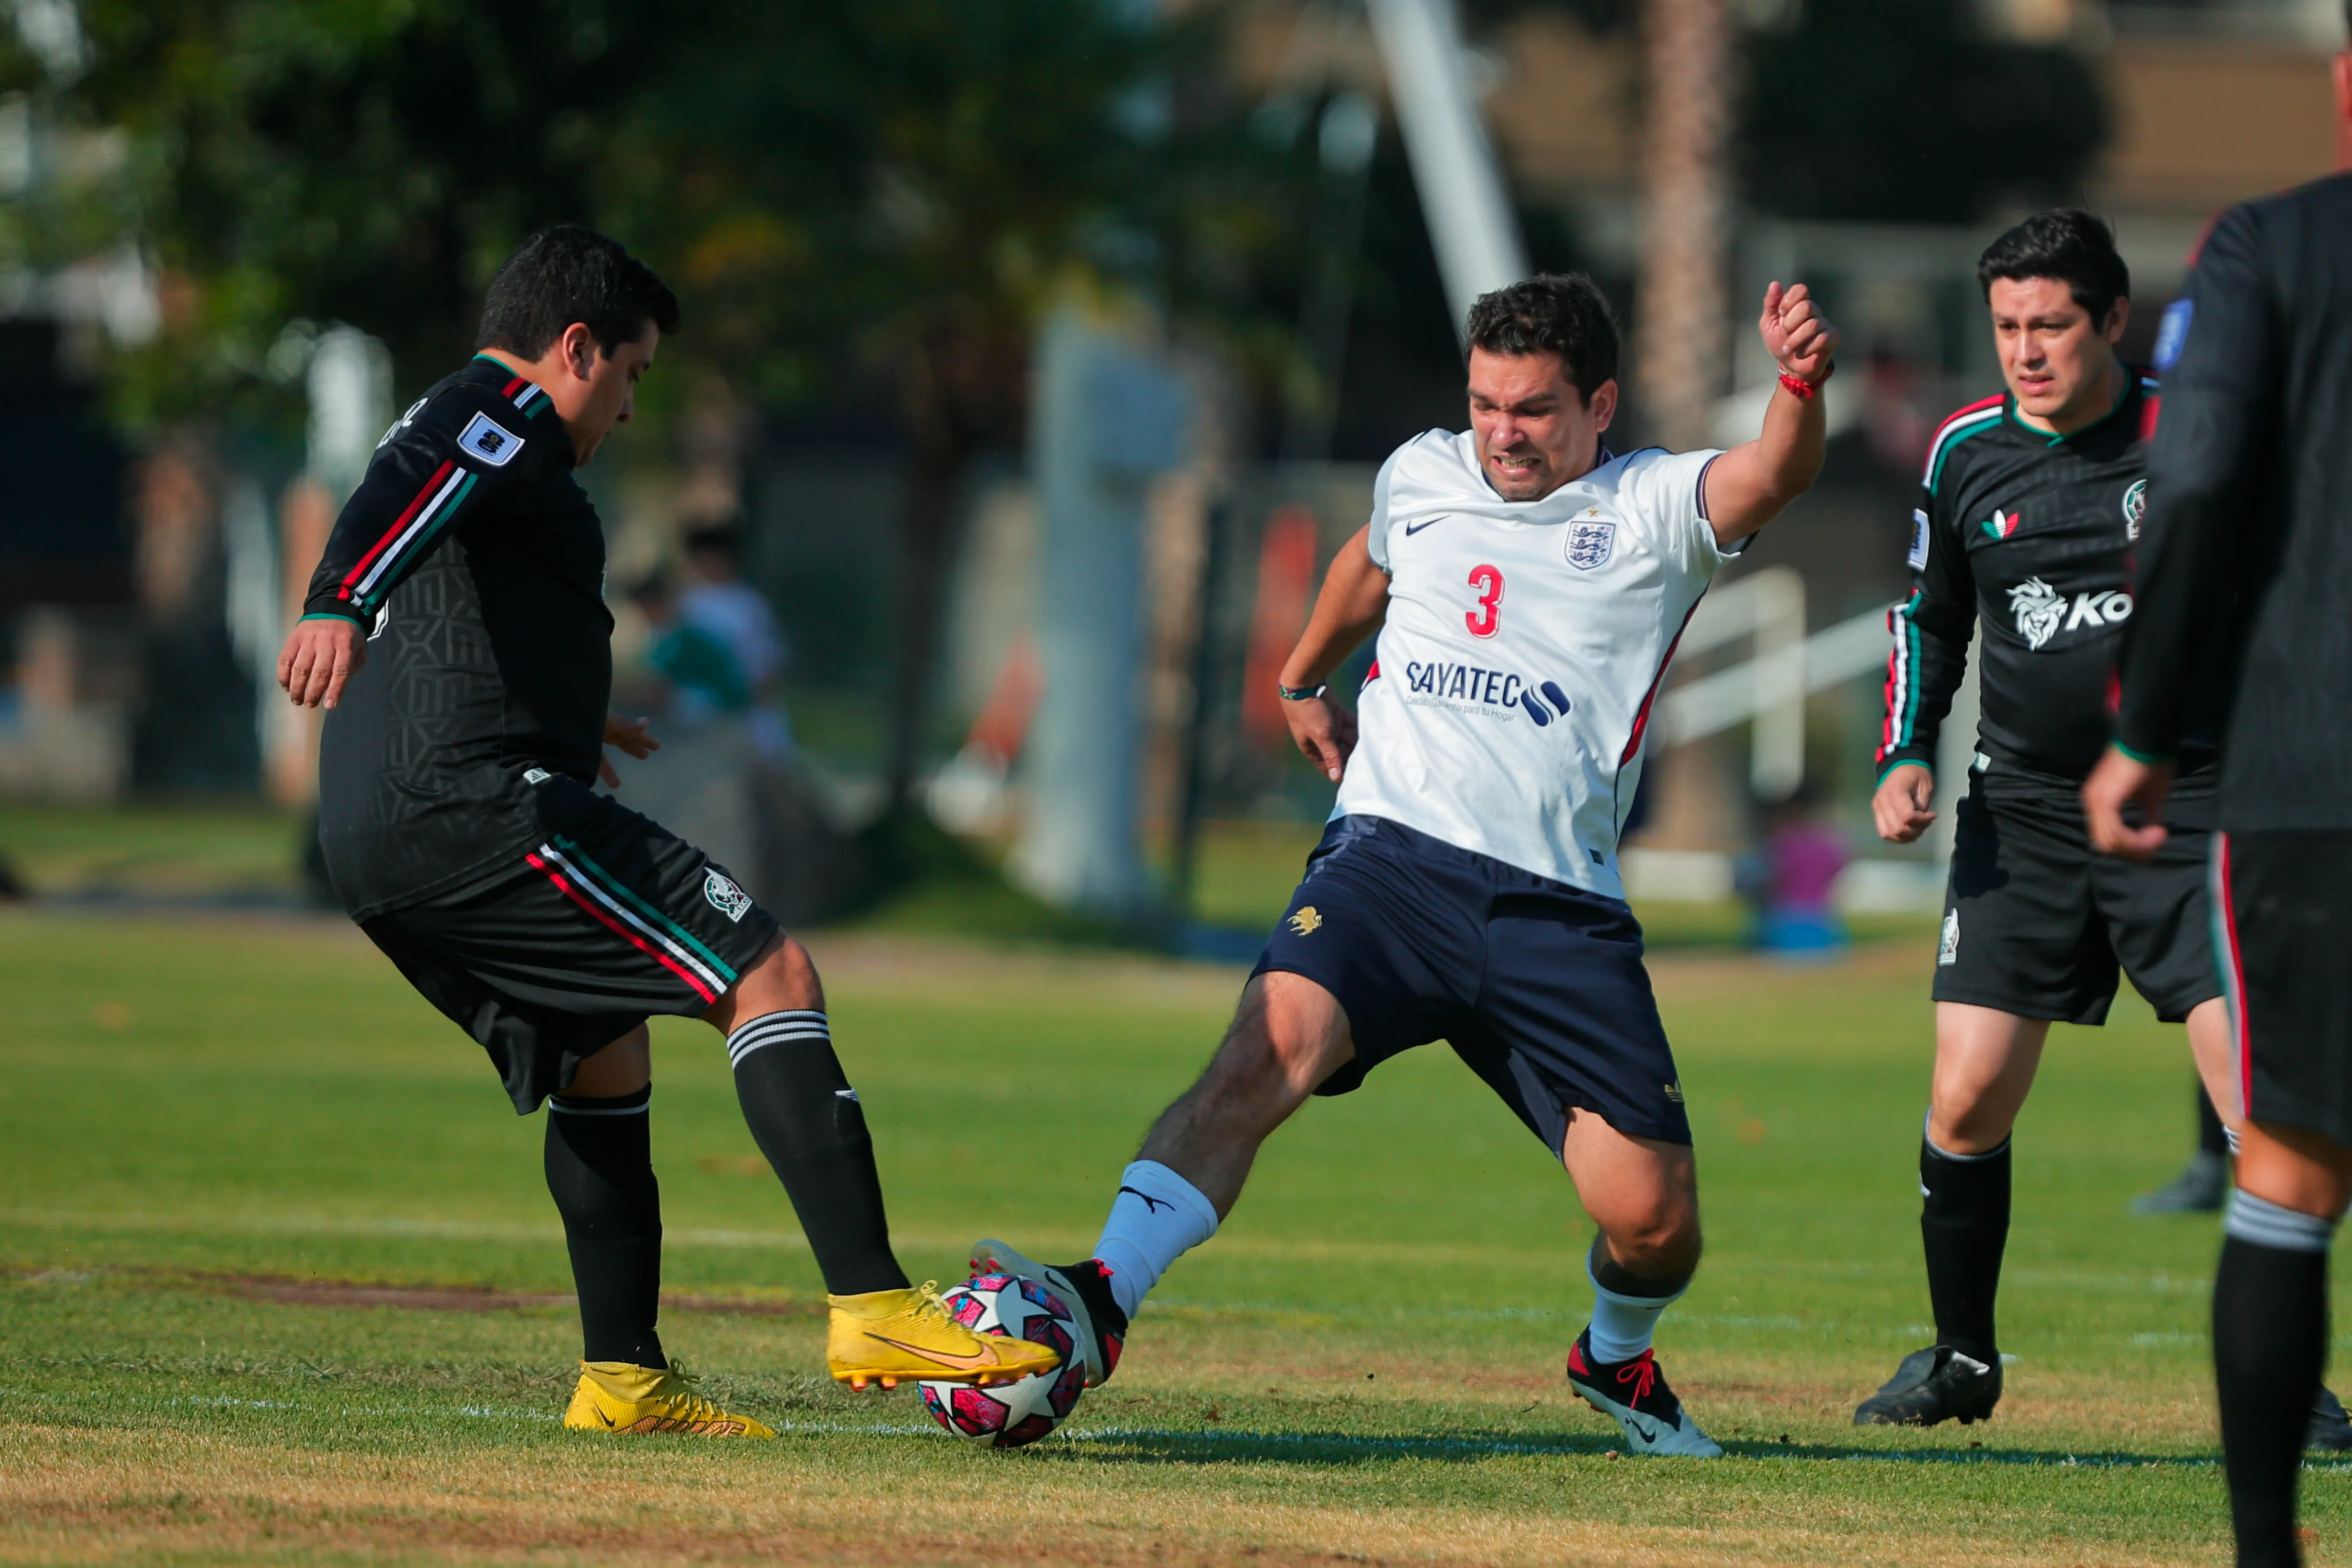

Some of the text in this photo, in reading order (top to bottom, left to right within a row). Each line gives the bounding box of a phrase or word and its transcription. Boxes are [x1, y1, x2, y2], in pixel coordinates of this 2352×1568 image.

[1466, 564, 1505, 639] 3
[1406, 661, 1521, 708] SAYATEC
[1463, 705, 1480, 715] para
[1482, 706, 1490, 716] tu
[1491, 708, 1516, 722] Hogar
